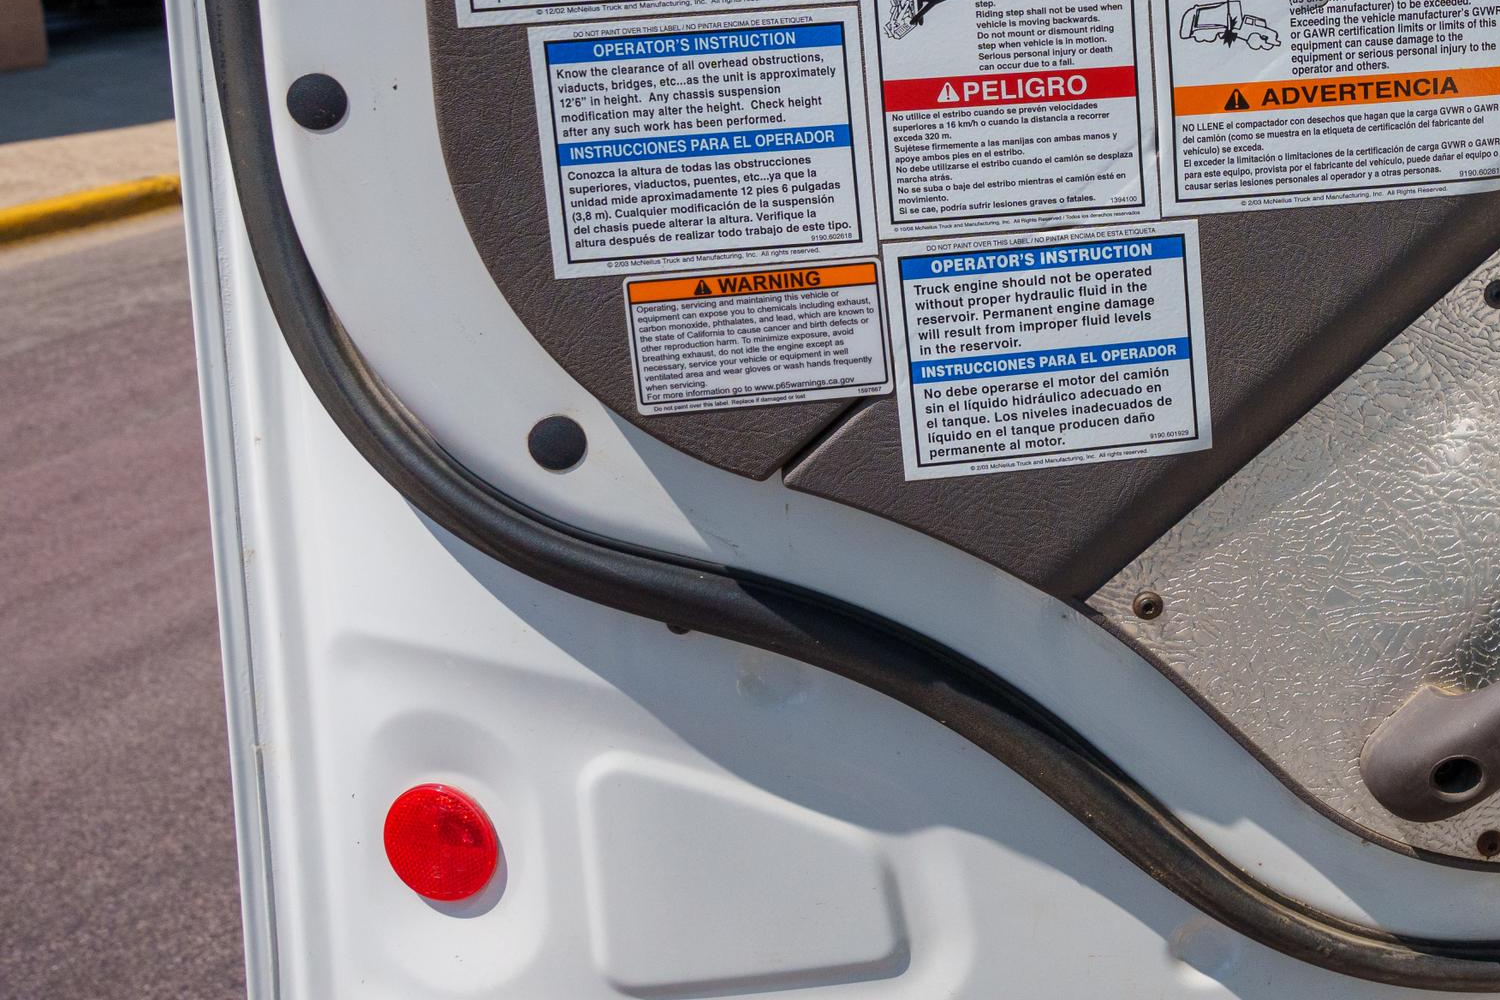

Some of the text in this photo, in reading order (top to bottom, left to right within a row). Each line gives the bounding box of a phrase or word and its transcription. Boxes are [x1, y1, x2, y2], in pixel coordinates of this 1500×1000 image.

[694, 31, 796, 50] INSTRUCTION
[1290, 17, 1497, 39] or GAWR certification limits or limits of this
[556, 52, 824, 79] Know the clearance of all overhead obstructions,
[1291, 60, 1389, 77] operator and others.
[963, 74, 1087, 102] PELIGRO
[1261, 76, 1458, 106] ADVERTENCIA
[891, 113, 904, 122] No
[905, 112, 931, 121] utilice
[932, 111, 940, 119] el
[942, 109, 972, 119] estribo
[973, 107, 1005, 116] cuando
[1018, 104, 1047, 115] prevén
[1048, 101, 1098, 111] velocidades
[570, 129, 835, 160] INSTRUCCIONES PARA EL OPERADOR
[575, 220, 851, 248] altura después de realizar todo trabajo de este tipo.
[1039, 242, 1152, 265] INSTRUCTION
[717, 270, 821, 294] WARNING
[913, 265, 1152, 296] Truck engine should not be operated
[914, 281, 1147, 311] without proper hydraulic fluid in the
[919, 337, 1021, 355] in the reservoir.
[921, 344, 1176, 378] INSTRUCCIONES PARA EL OPERADOR
[662, 392, 684, 400] more
[685, 388, 731, 398] information
[731, 387, 743, 396] go
[744, 385, 753, 395] to
[754, 377, 855, 392] www.p65warnings.ca.gov
[923, 366, 1169, 399] No debe operarse el motor del camión
[929, 436, 1065, 460] permanente al motor.
